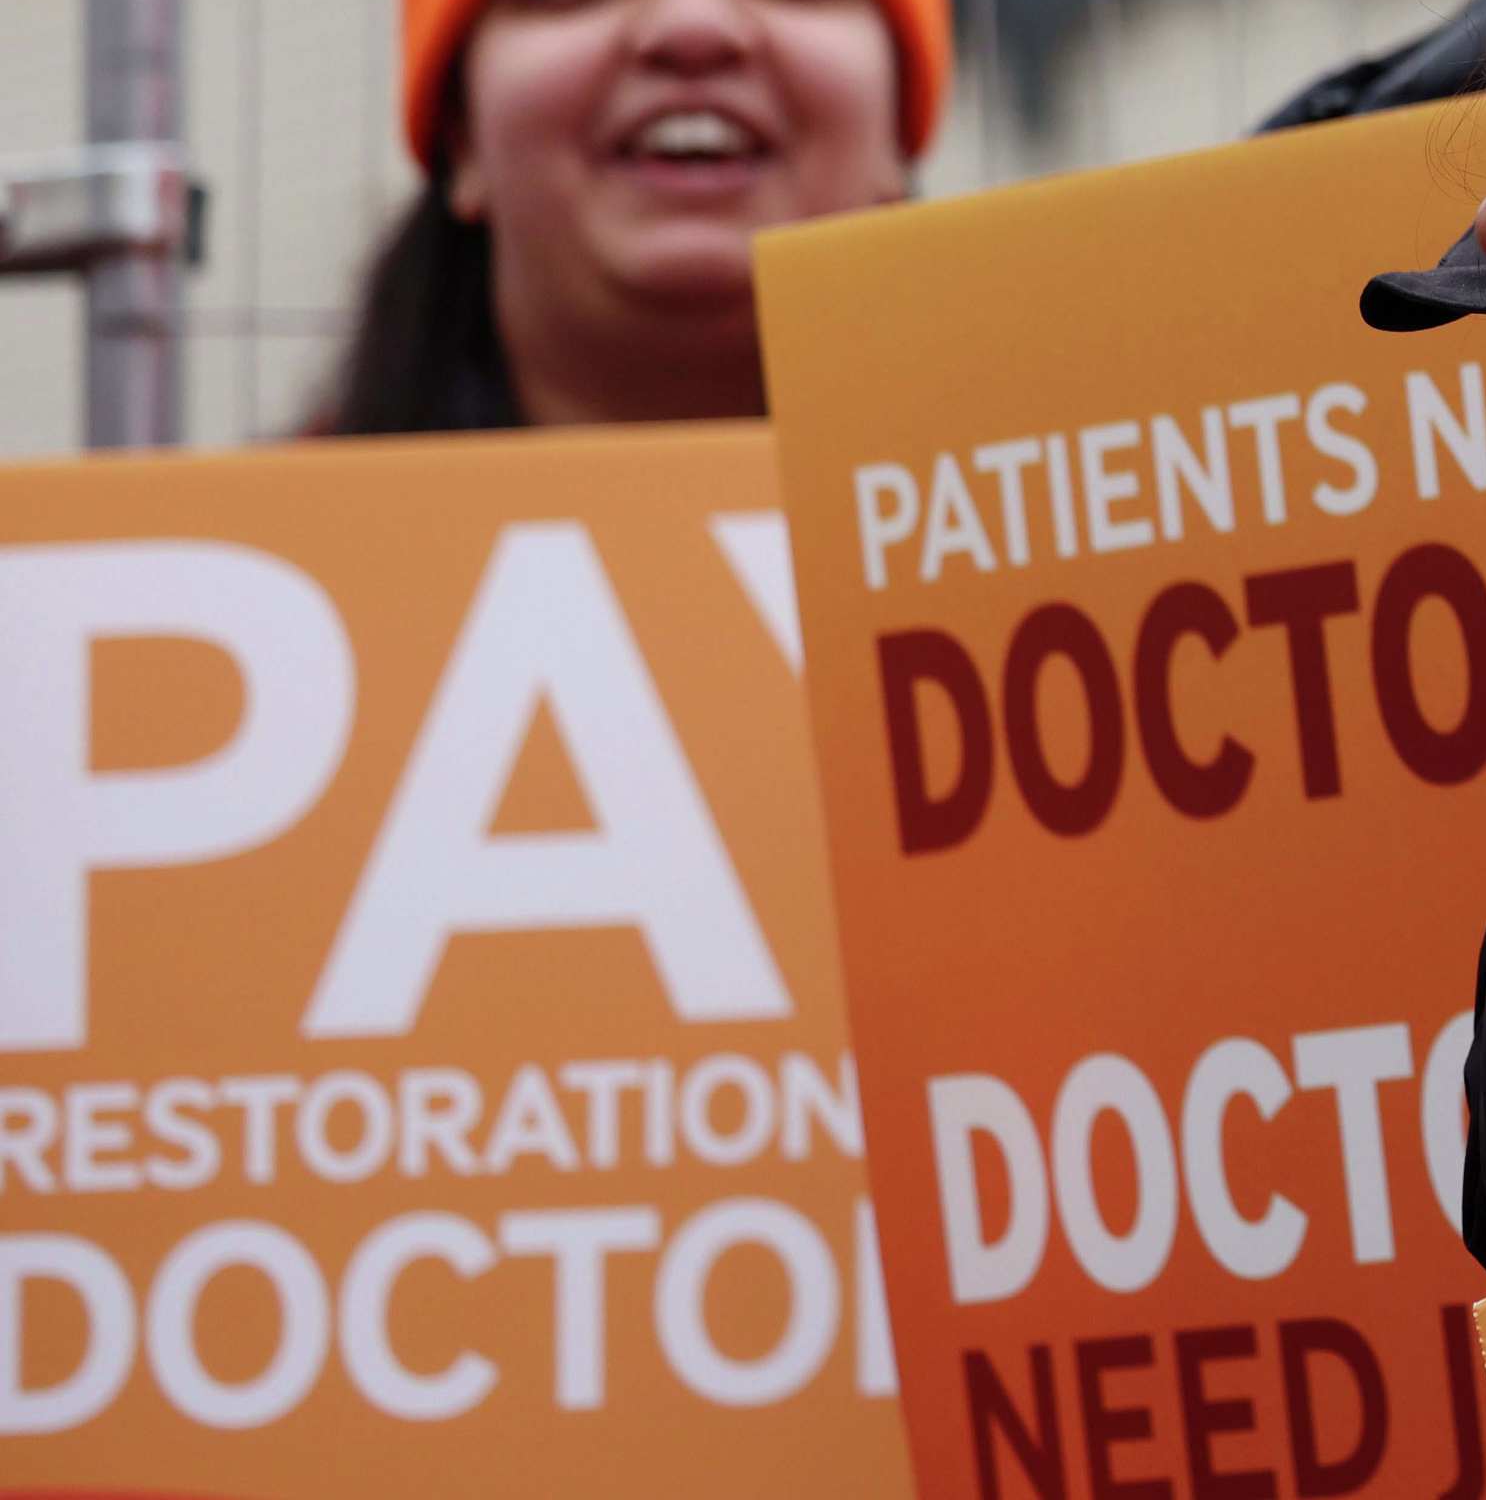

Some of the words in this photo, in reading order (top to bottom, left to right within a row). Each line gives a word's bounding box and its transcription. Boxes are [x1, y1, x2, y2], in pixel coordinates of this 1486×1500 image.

[853, 382, 1380, 592] PATIENTS
[0, 1050, 868, 1196] RESTORATION
[961, 1316, 1390, 1500] NEED
